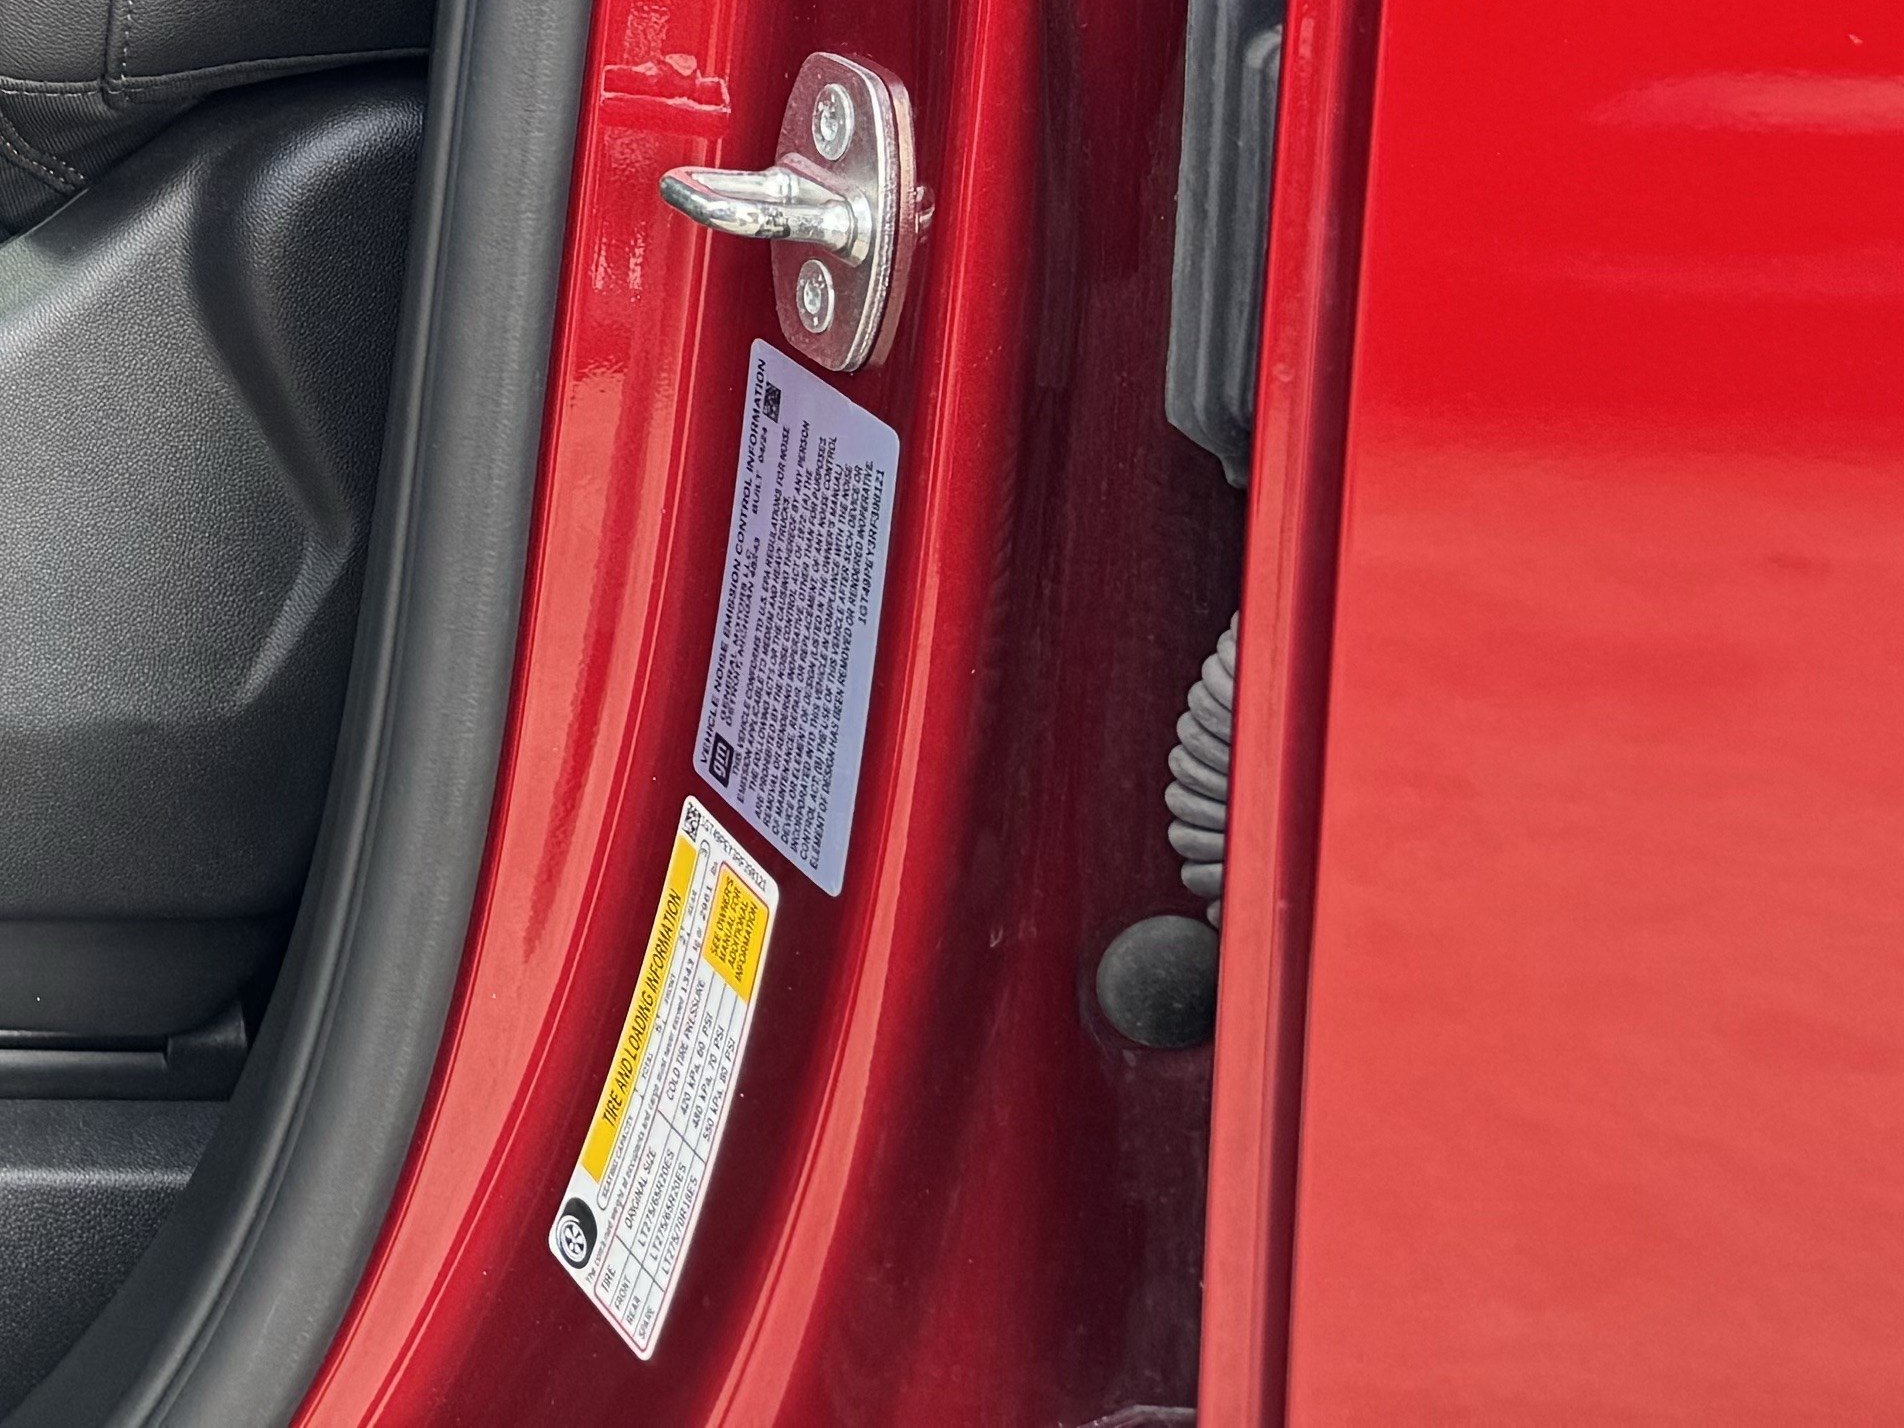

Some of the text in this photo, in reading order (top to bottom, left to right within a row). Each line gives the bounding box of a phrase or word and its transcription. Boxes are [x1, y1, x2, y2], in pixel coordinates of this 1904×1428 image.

[700, 357, 767, 769] VEHICLE NOISE EMISSION CONTROL INFORMATION
[713, 739, 729, 781] gm
[709, 930, 721, 957] SEE
[717, 885, 742, 963] MANUAL FOR
[724, 897, 751, 969] ADDITIONAL
[731, 900, 760, 983] INFORMATION
[601, 887, 684, 1131] TIRE AND LOADING INFORMATION
[600, 1261, 616, 1295] TIRE
[624, 1171, 647, 1232] ORIGINAL
[665, 1064, 681, 1102] COLD
[682, 976, 706, 1041] PRESSURE
